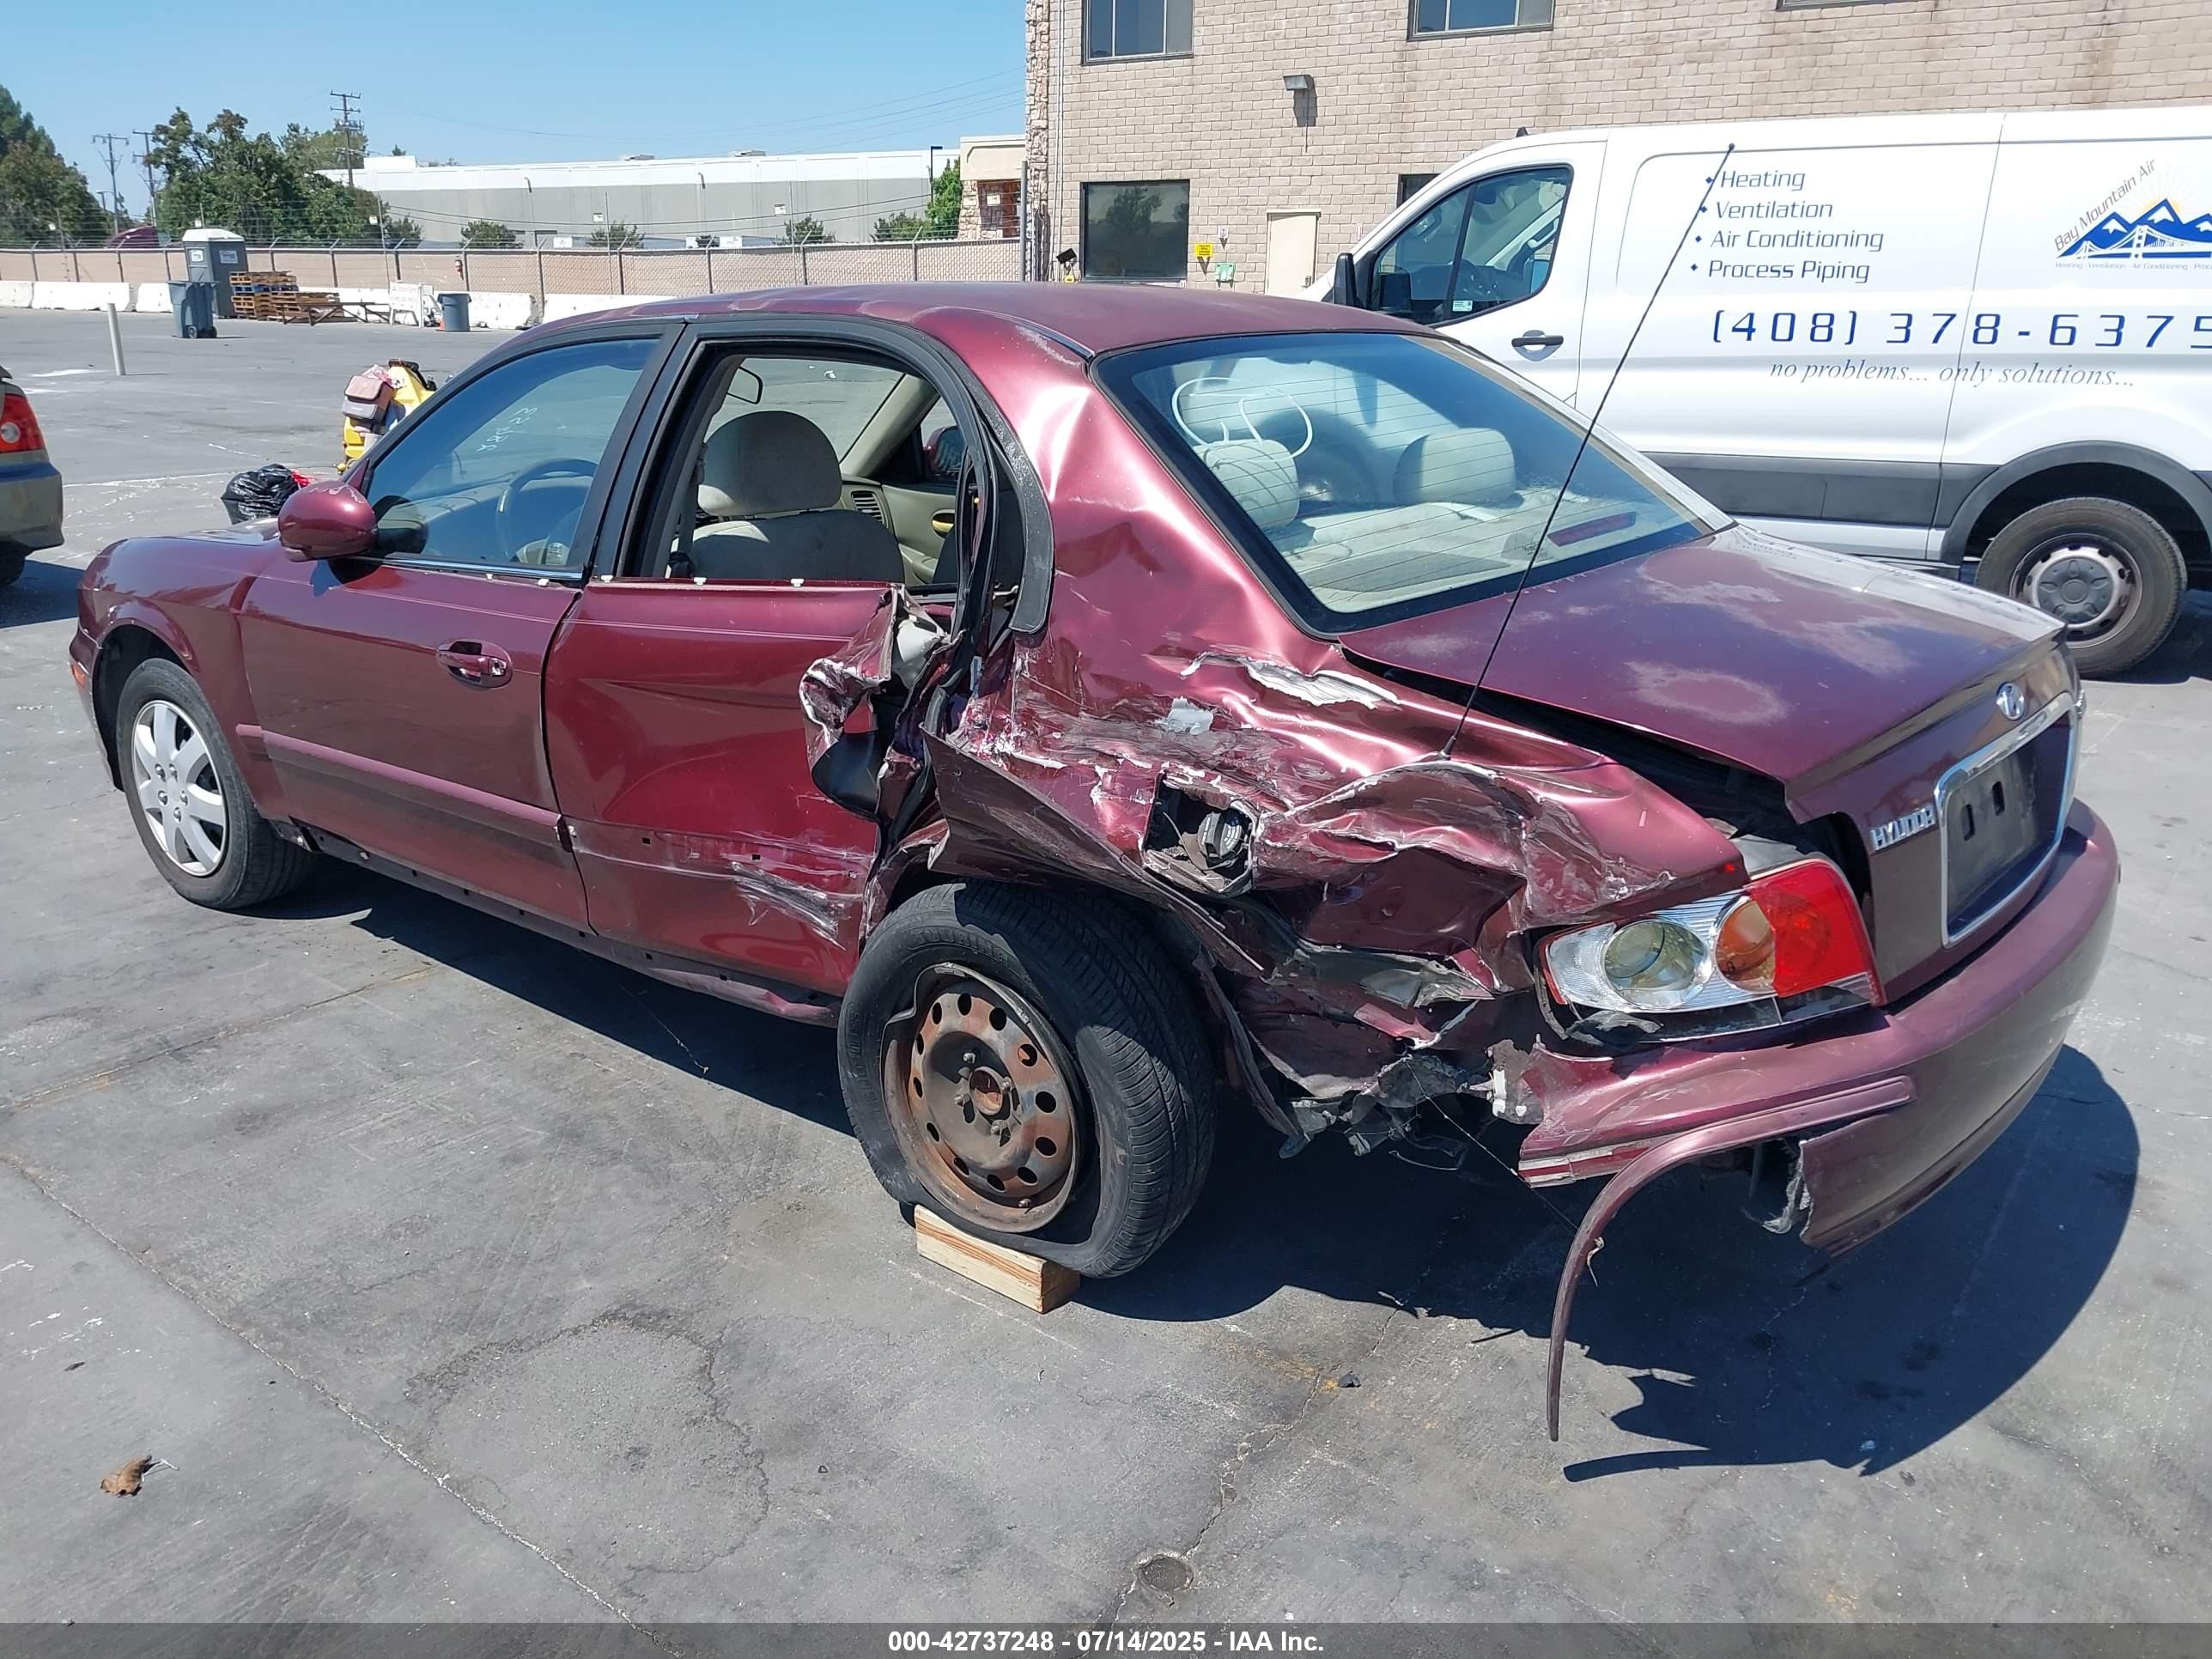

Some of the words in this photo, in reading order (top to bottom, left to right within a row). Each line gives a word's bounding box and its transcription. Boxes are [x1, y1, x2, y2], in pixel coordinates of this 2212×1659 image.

[1721, 170, 1806, 191] Heating
[1717, 200, 1833, 219] Ventilation
[2054, 225, 2080, 252] Bay
[2079, 177, 2137, 231] Mountain
[2138, 159, 2155, 182] Air
[1710, 230, 1741, 248] Air
[1747, 229, 1884, 252] Conditioning
[1709, 259, 1795, 278] Process
[1801, 260, 1870, 284] Piping
[1713, 310, 1857, 345] (408)
[1770, 363, 1797, 378] no
[1801, 359, 1928, 383] problems...
[1939, 361, 1993, 387] only
[1998, 362, 2134, 386] solutions...
